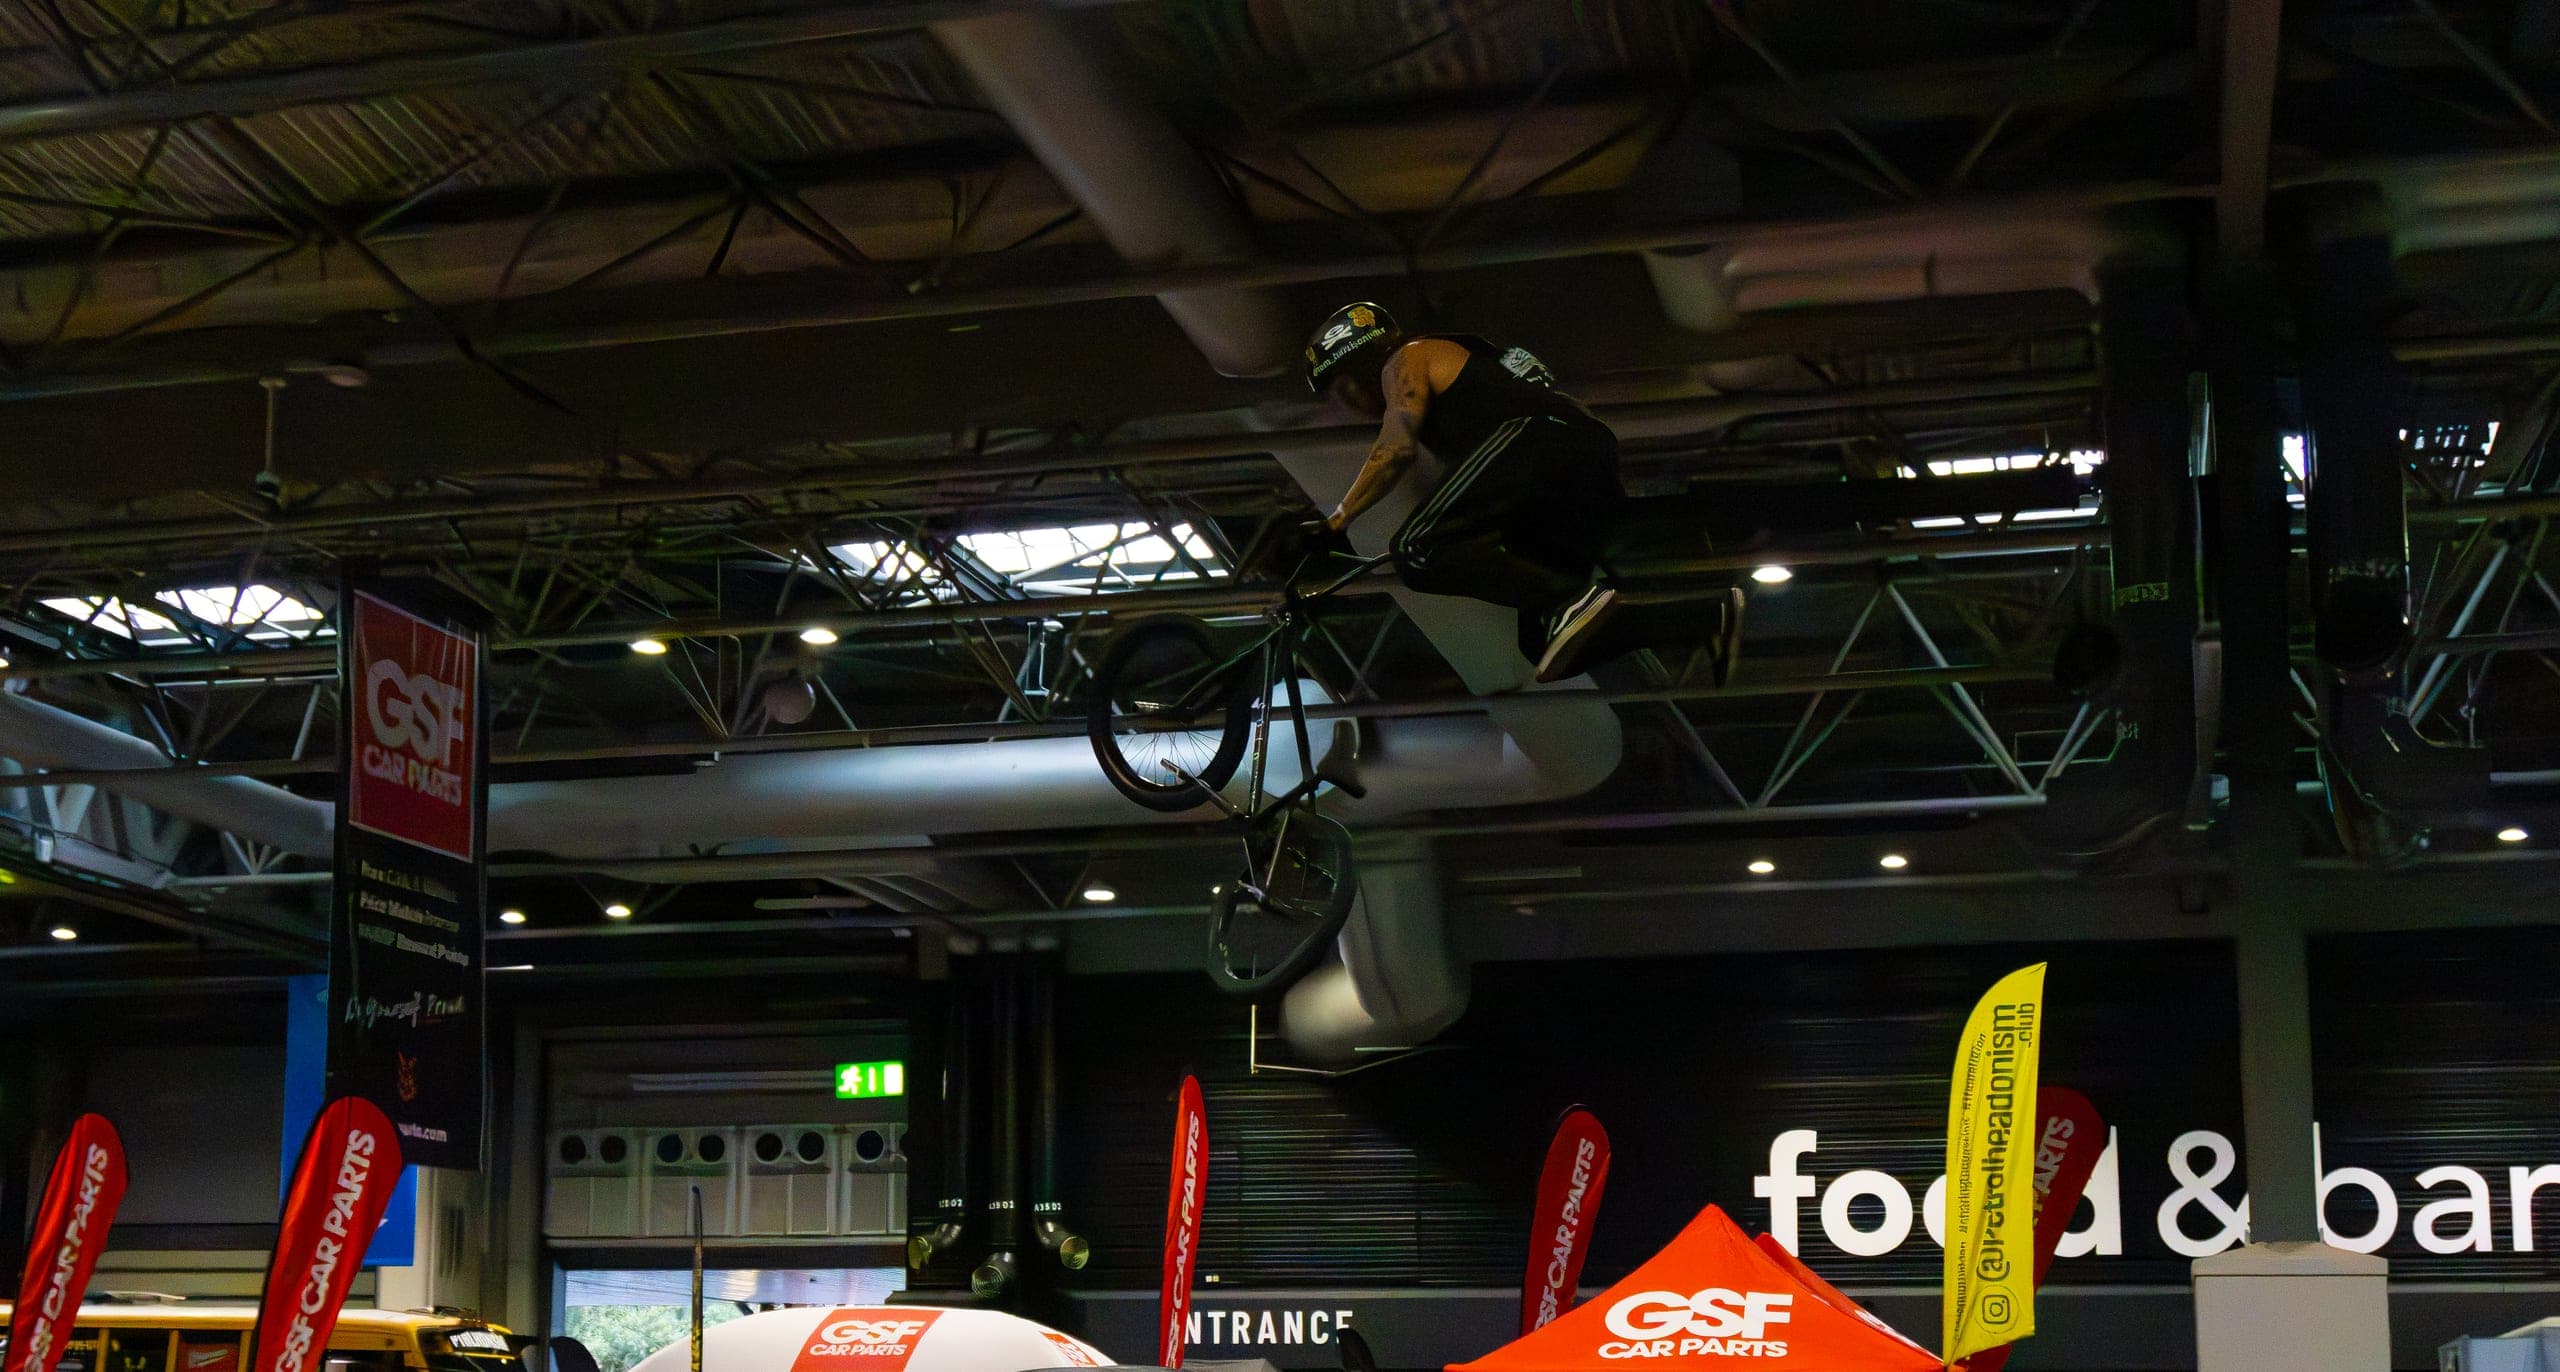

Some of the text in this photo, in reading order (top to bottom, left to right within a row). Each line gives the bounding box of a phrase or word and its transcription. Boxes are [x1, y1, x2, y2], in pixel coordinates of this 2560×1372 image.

[1561, 1137, 1596, 1227] PARTS
[1753, 1125, 2123, 1258] fod
[300, 1236, 344, 1316] CAR
[322, 1128, 377, 1238] PARTS
[1547, 1224, 1577, 1289] CAR
[820, 1319, 927, 1345] GSF
[1184, 1309, 1354, 1345] NTRANCE
[1604, 1287, 1794, 1341] GSF
[809, 1343, 908, 1356] CAR PARTS
[1597, 1337, 1788, 1360] CAR PARTS
